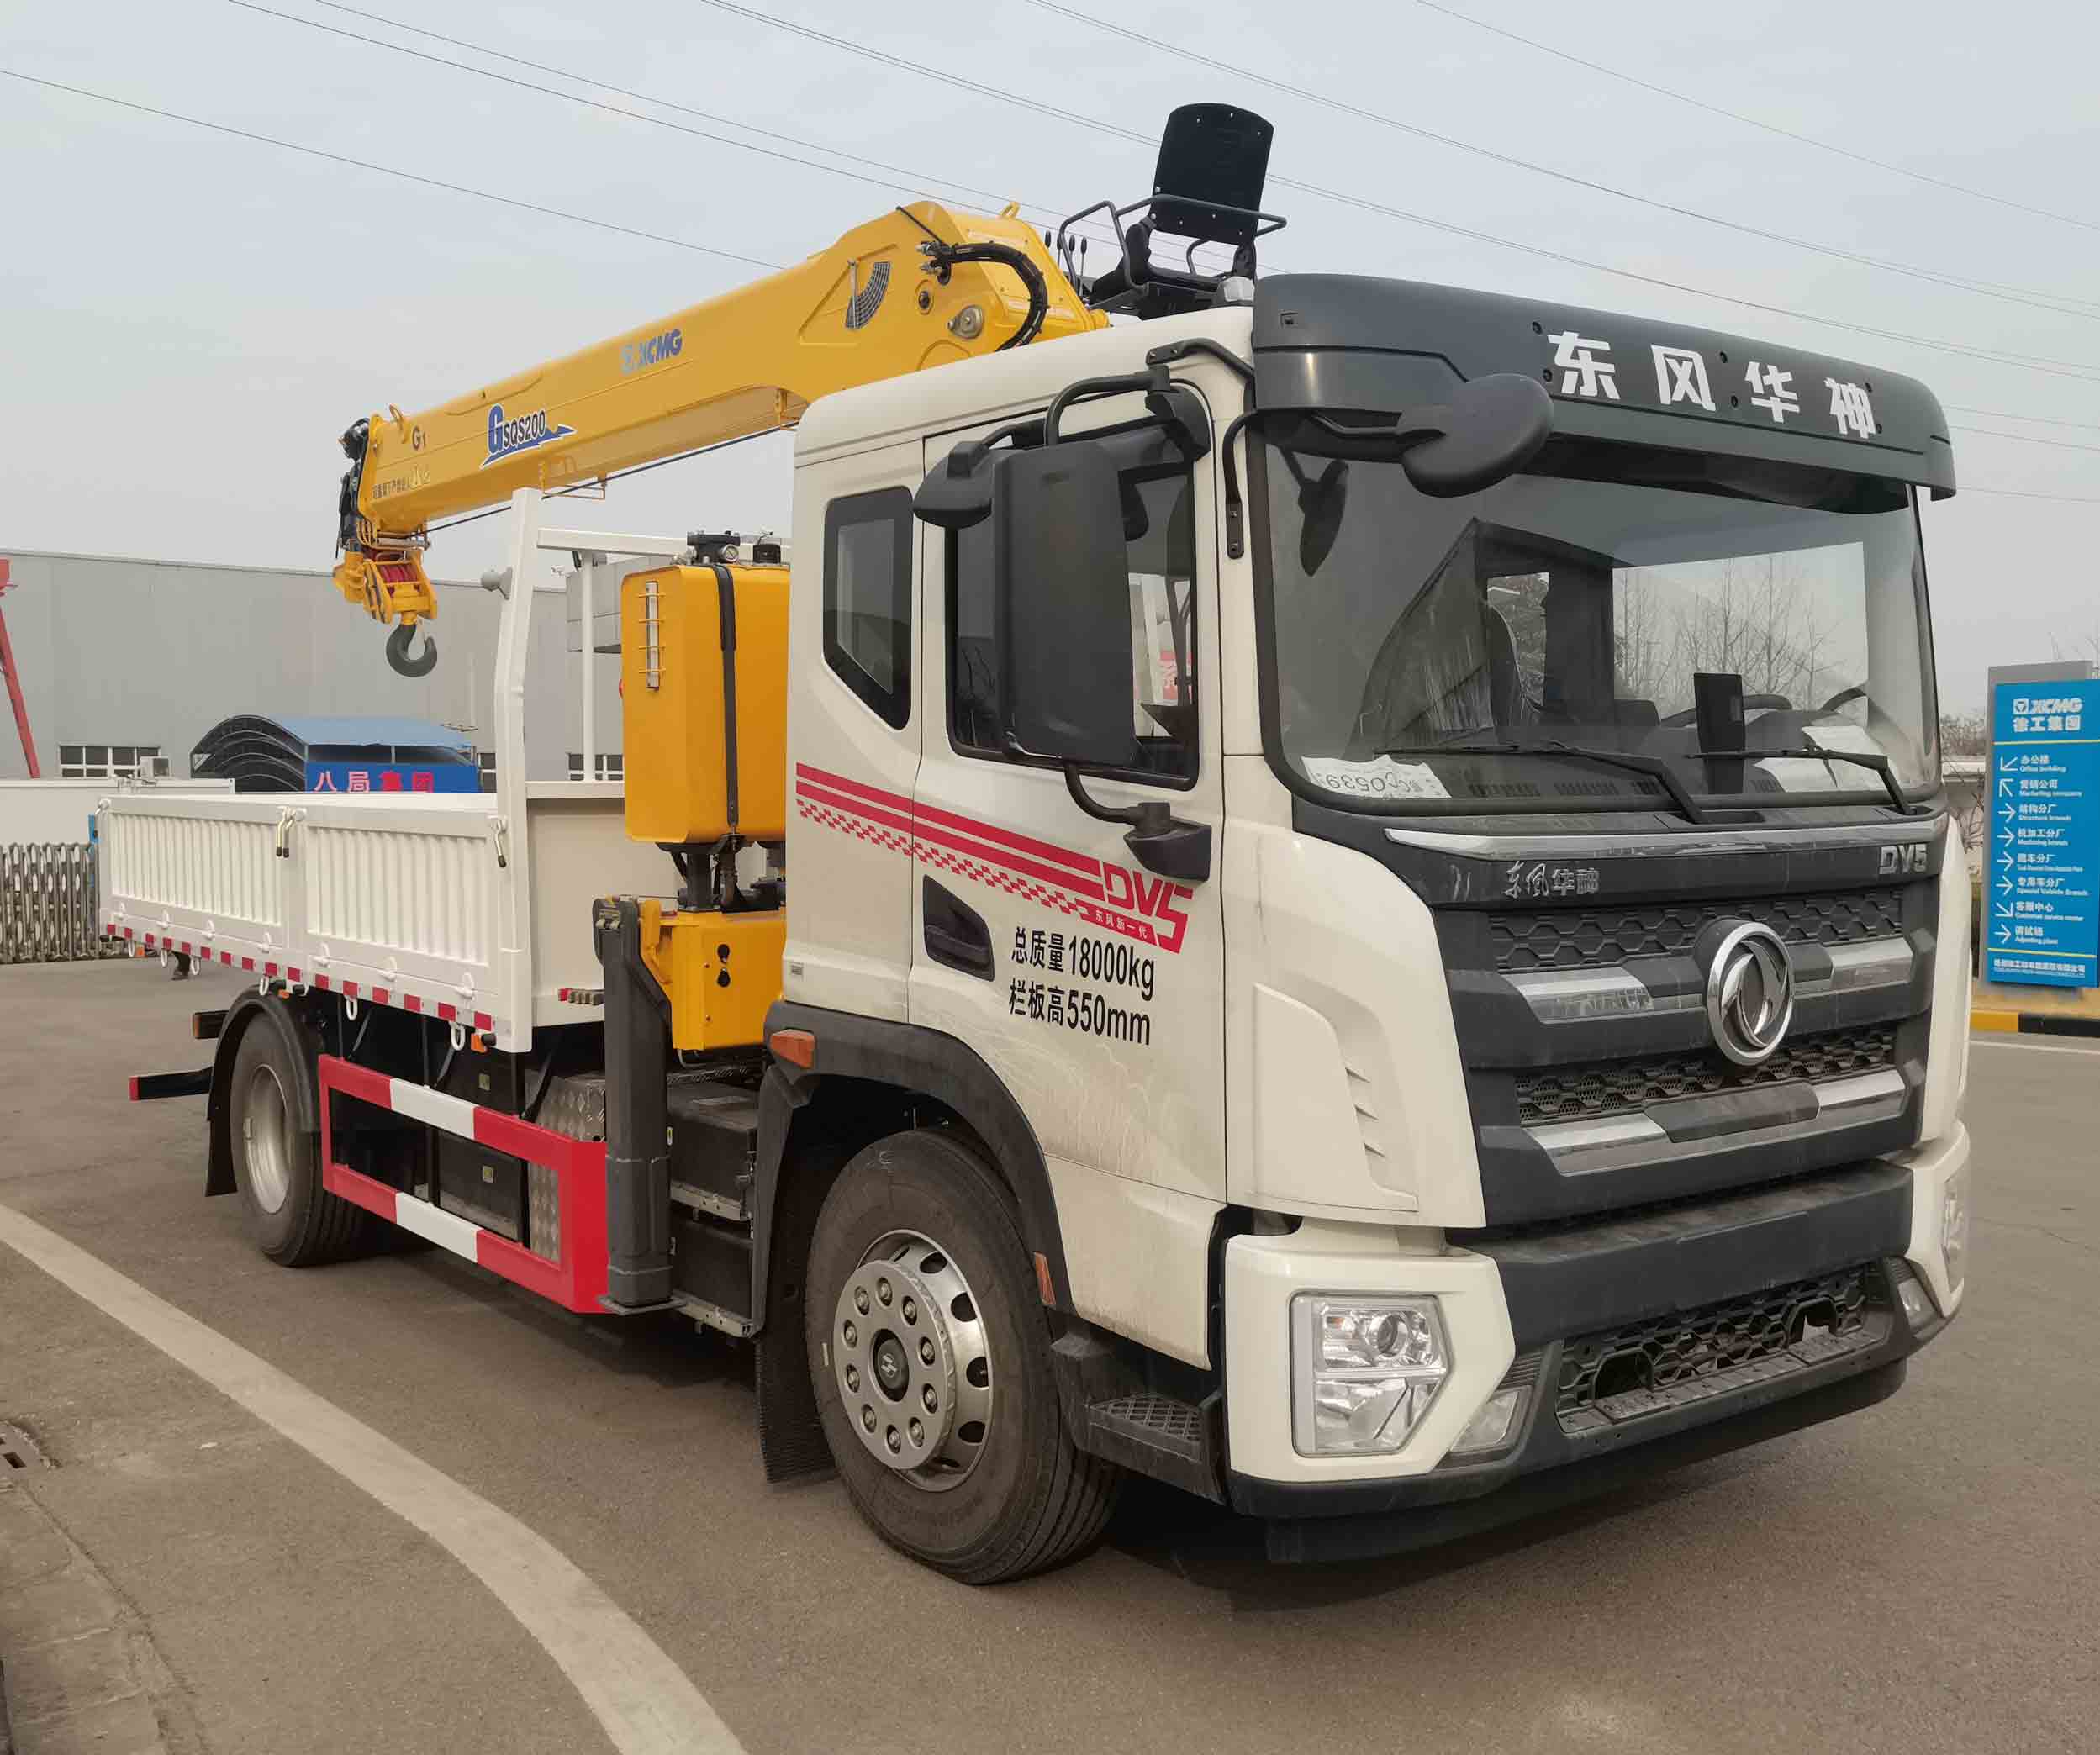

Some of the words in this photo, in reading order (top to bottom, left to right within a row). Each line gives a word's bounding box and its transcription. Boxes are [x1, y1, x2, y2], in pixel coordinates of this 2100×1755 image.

[1547, 331, 1876, 439] 东风华神
[1880, 844, 1927, 874] DV5
[1102, 861, 1194, 954] DV5
